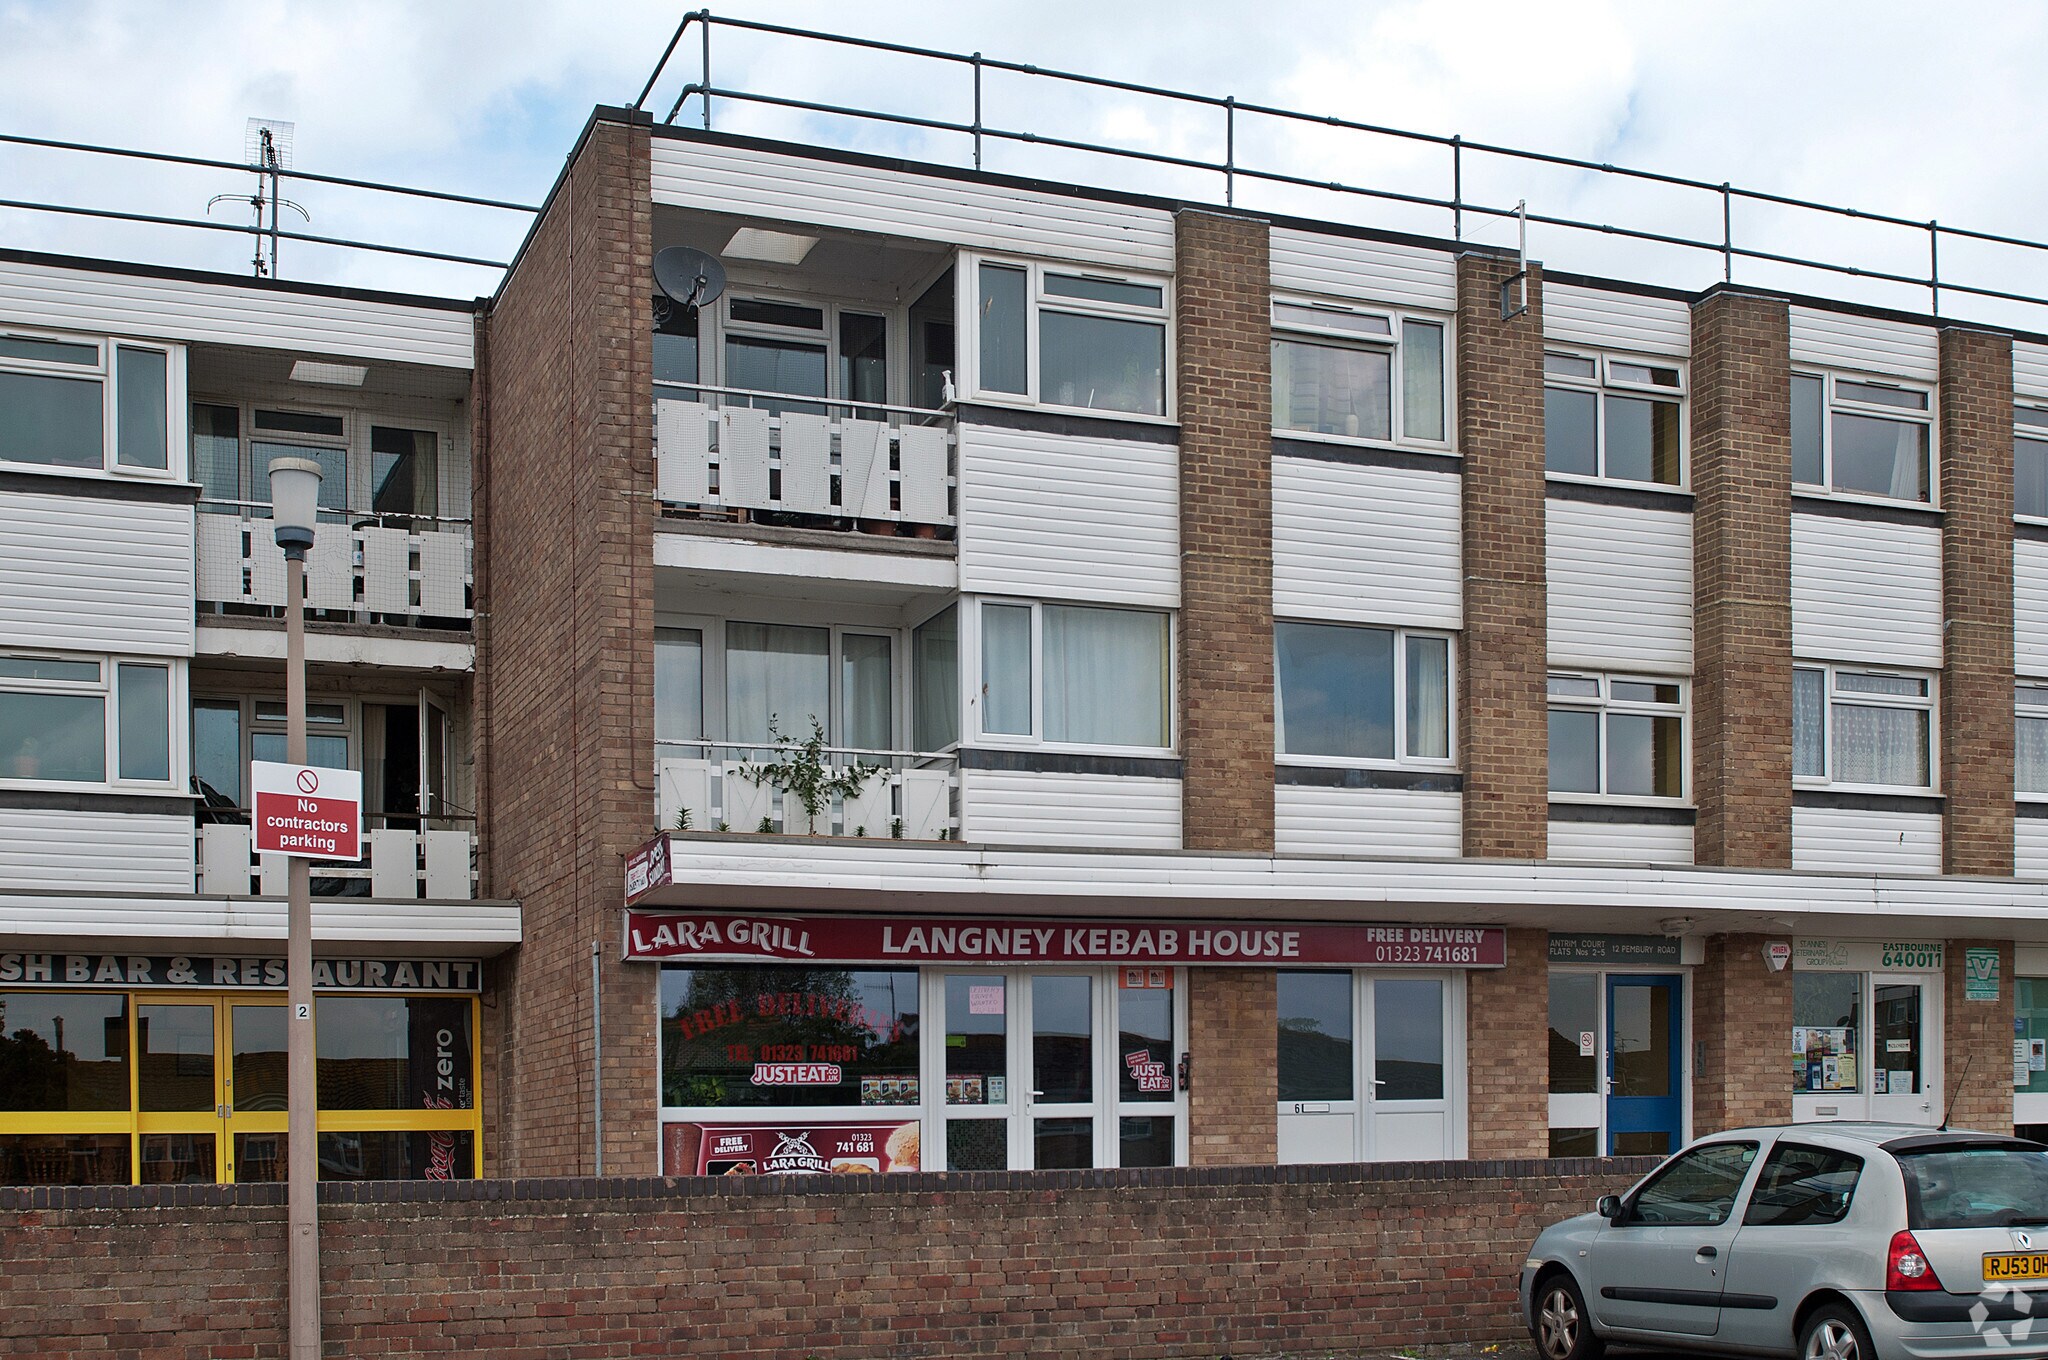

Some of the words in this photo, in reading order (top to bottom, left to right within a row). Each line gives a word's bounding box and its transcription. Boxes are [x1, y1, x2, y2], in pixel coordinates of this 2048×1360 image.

[298, 798, 318, 813] No
[266, 816, 348, 833] contractors
[280, 834, 336, 852] parking
[632, 920, 724, 952] LARA
[726, 919, 816, 957] GRILL
[882, 926, 1055, 956] LANGNEY
[1063, 928, 1178, 956] KEBAB
[1188, 930, 1300, 957] HOUSE
[1367, 928, 1404, 943] FREE
[1410, 929, 1485, 944] DELIVERY
[1550, 940, 1577, 948] ANTRIM
[1582, 940, 1606, 948] COURT
[1612, 945, 1620, 953] 12
[1622, 946, 1654, 954] PEMBURY
[1657, 946, 1676, 954] ROAD
[1882, 943, 1942, 952] EASTBOURNE
[1376, 946, 1420, 962] 01323
[1424, 946, 1478, 962] 741681
[1550, 948, 1571, 956] FLATS
[1882, 952, 1942, 968] 640011
[66, 955, 153, 983] BAR
[166, 957, 199, 984] &
[213, 958, 473, 988] RESAURANT
[299, 1006, 307, 1018] 2
[436, 1028, 454, 1090] zero
[754, 1066, 794, 1083] JUST
[796, 1066, 828, 1083] EAT
[1133, 1064, 1162, 1078] JUST
[1140, 1077, 1162, 1089] EAT
[1294, 1104, 1300, 1114] 6
[720, 1136, 743, 1146] FREE
[852, 1134, 872, 1142] 01323
[714, 1144, 749, 1154] DELIVERY
[836, 1142, 854, 1153] 741
[856, 1142, 874, 1153] 681
[763, 1158, 797, 1171] LARA
[797, 1157, 831, 1172] GRILL
[1991, 1258, 2029, 1276] RJ53
